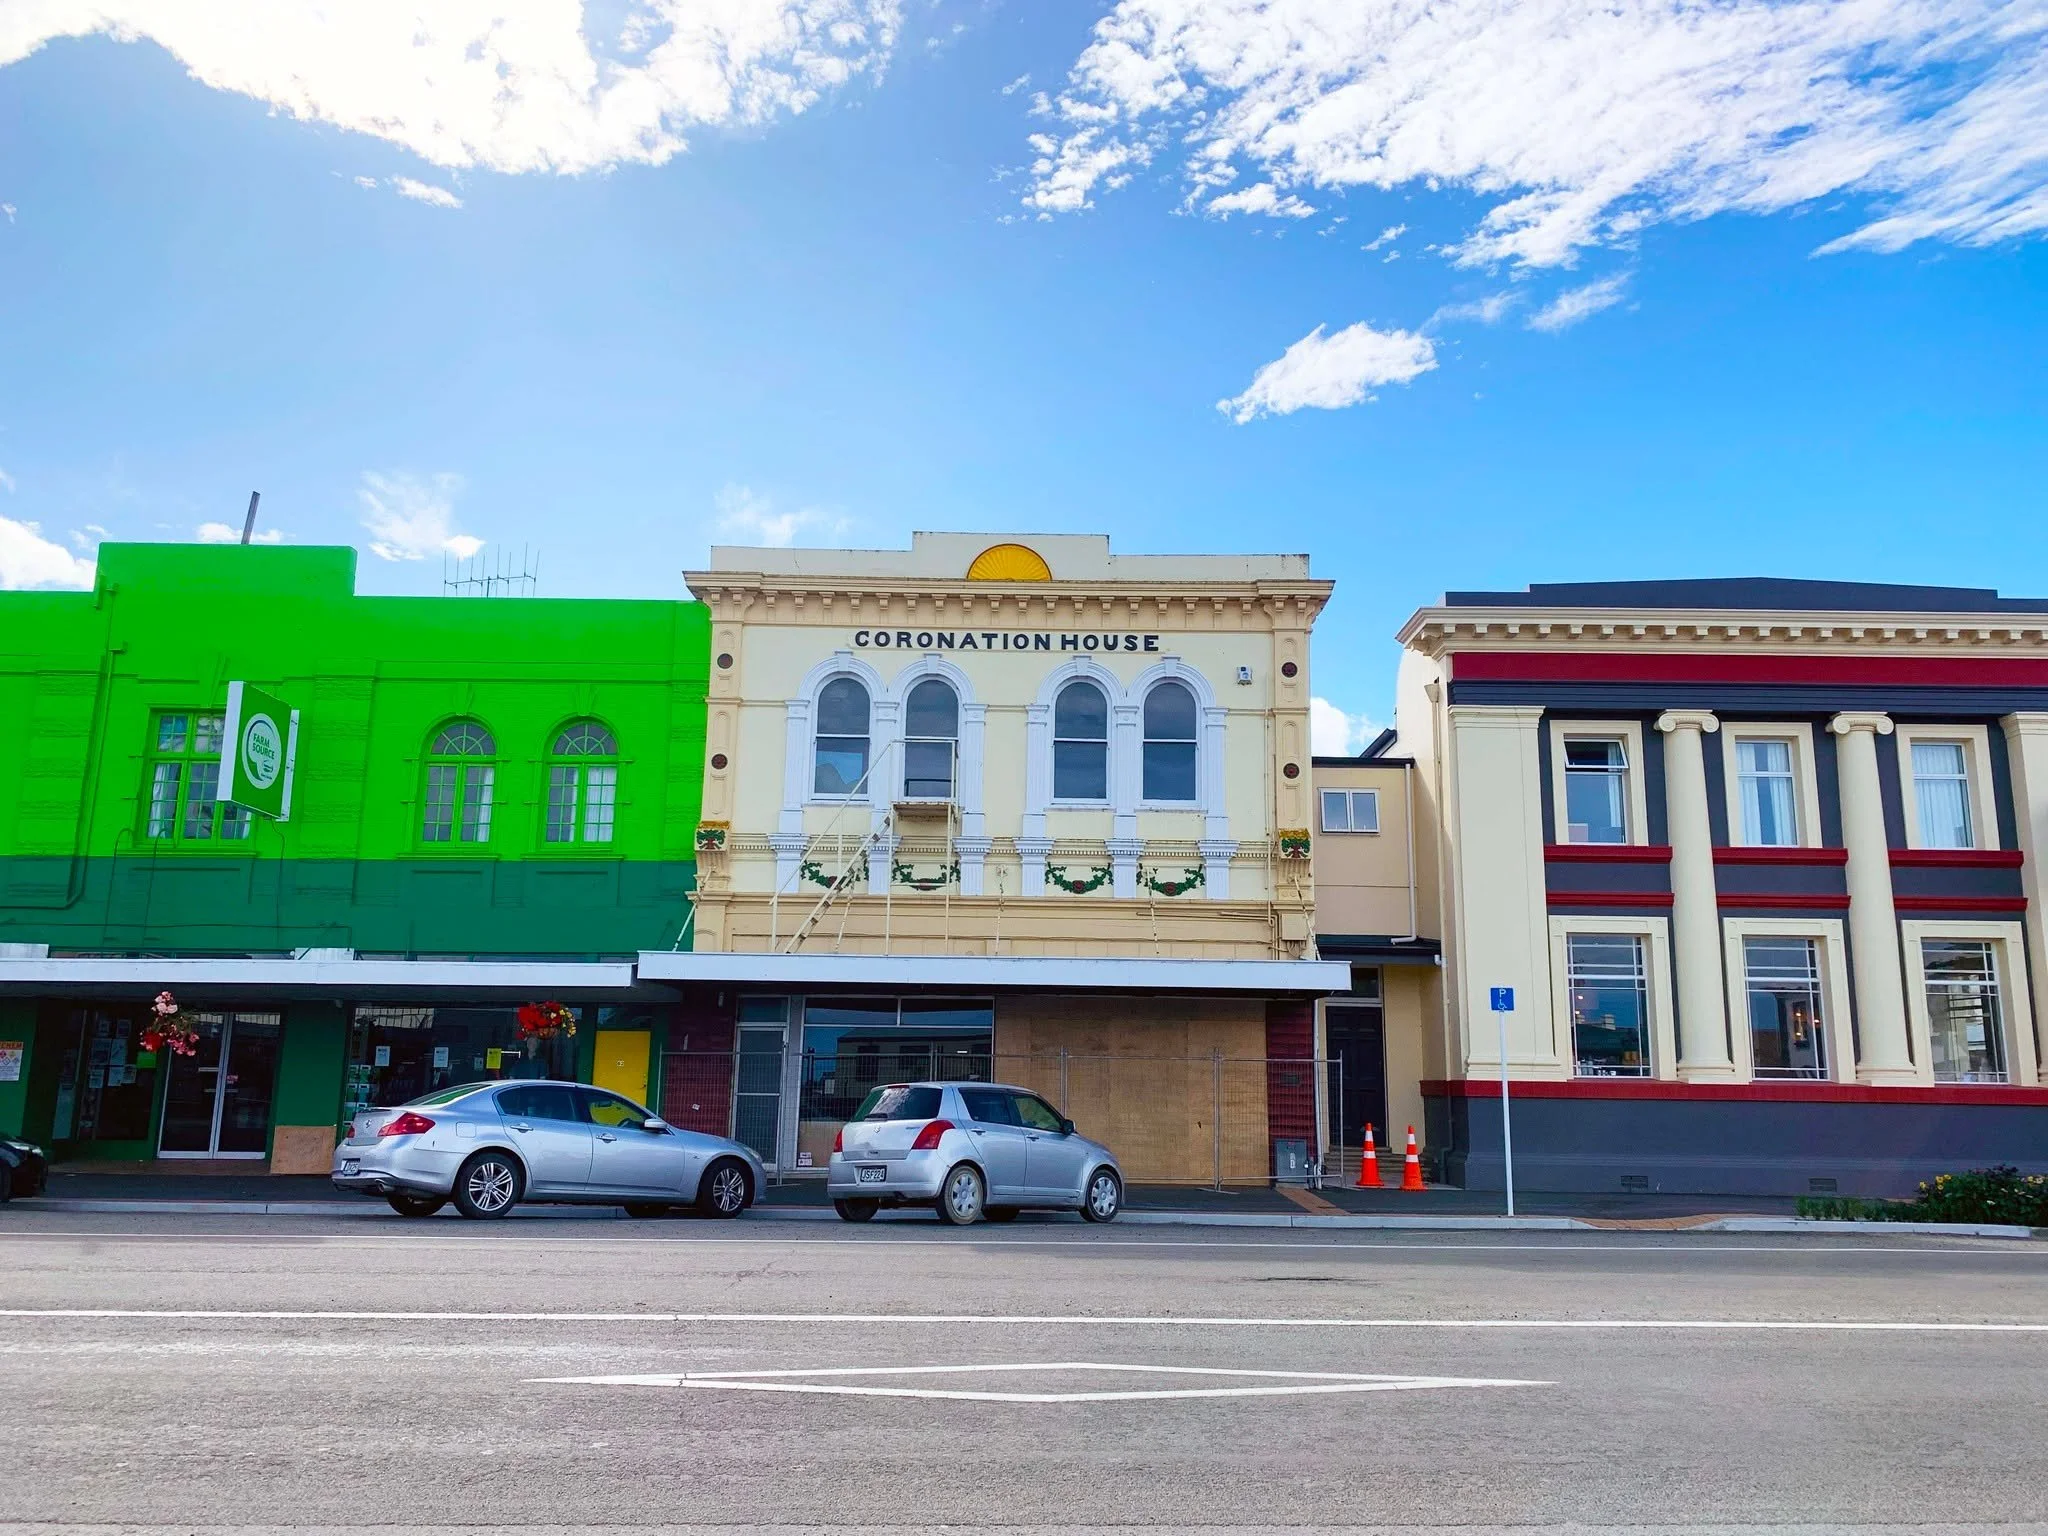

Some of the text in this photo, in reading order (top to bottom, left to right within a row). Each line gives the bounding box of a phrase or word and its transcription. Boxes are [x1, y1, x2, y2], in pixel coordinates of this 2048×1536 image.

[854, 630, 1159, 652] CORONATION HOUSE
[253, 733, 270, 748] FARM
[252, 742, 275, 760] SOURCE
[1499, 989, 1507, 997] P
